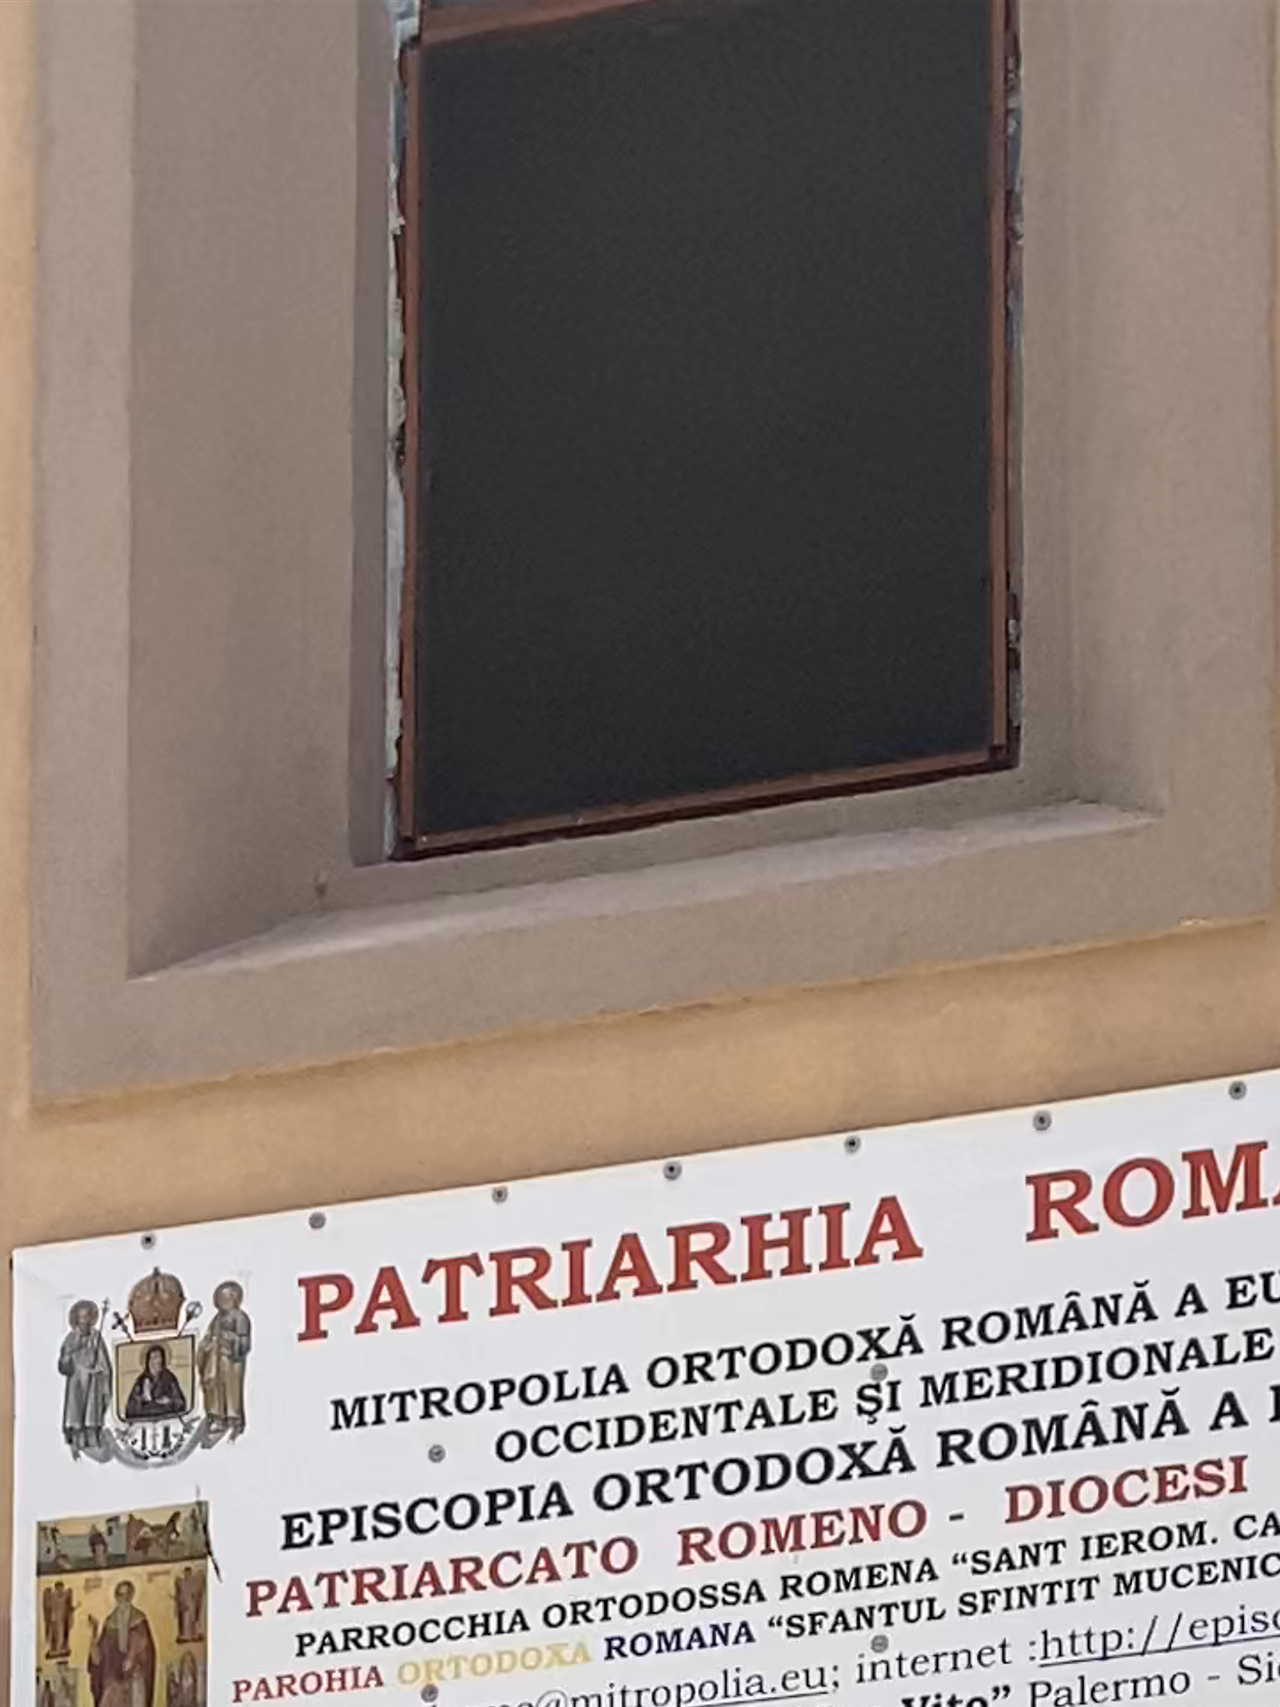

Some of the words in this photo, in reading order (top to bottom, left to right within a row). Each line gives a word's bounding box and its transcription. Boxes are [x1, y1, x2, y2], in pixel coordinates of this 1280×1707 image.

[296, 1194, 925, 1344] PATRIARHIA
[329, 1362, 632, 1432] MITROPOLIA
[645, 1312, 926, 1390] ORTODOXĂ
[939, 1278, 1160, 1352] ROMÂNĂ
[1172, 1282, 1210, 1319] A
[494, 1387, 840, 1465] OCCIDENTALE
[918, 1326, 1276, 1409] MERIDIONALE
[244, 1535, 640, 1619] PATRIARCATO
[676, 1498, 928, 1568] ROMENO
[1003, 1453, 1249, 1526] DIOCESI
[279, 1479, 576, 1552] EPISCOPIA
[591, 1423, 918, 1513] ORTODOXĂ
[935, 1386, 1192, 1470] ROMÂNĂ
[1207, 1389, 1250, 1433] A
[231, 1664, 386, 1704] PAROHIA
[396, 1635, 594, 1686] ORTODOXA
[603, 1619, 758, 1662] ROMANA
[956, 1572, 1102, 1619] SFINTIT
[294, 1607, 532, 1659] PARROCCHIA
[541, 1577, 769, 1630] ORTODOSSA
[777, 1556, 941, 1602] ROMENA
[1079, 1518, 1219, 1563] IEROM.
[855, 1636, 1014, 1685] internet
